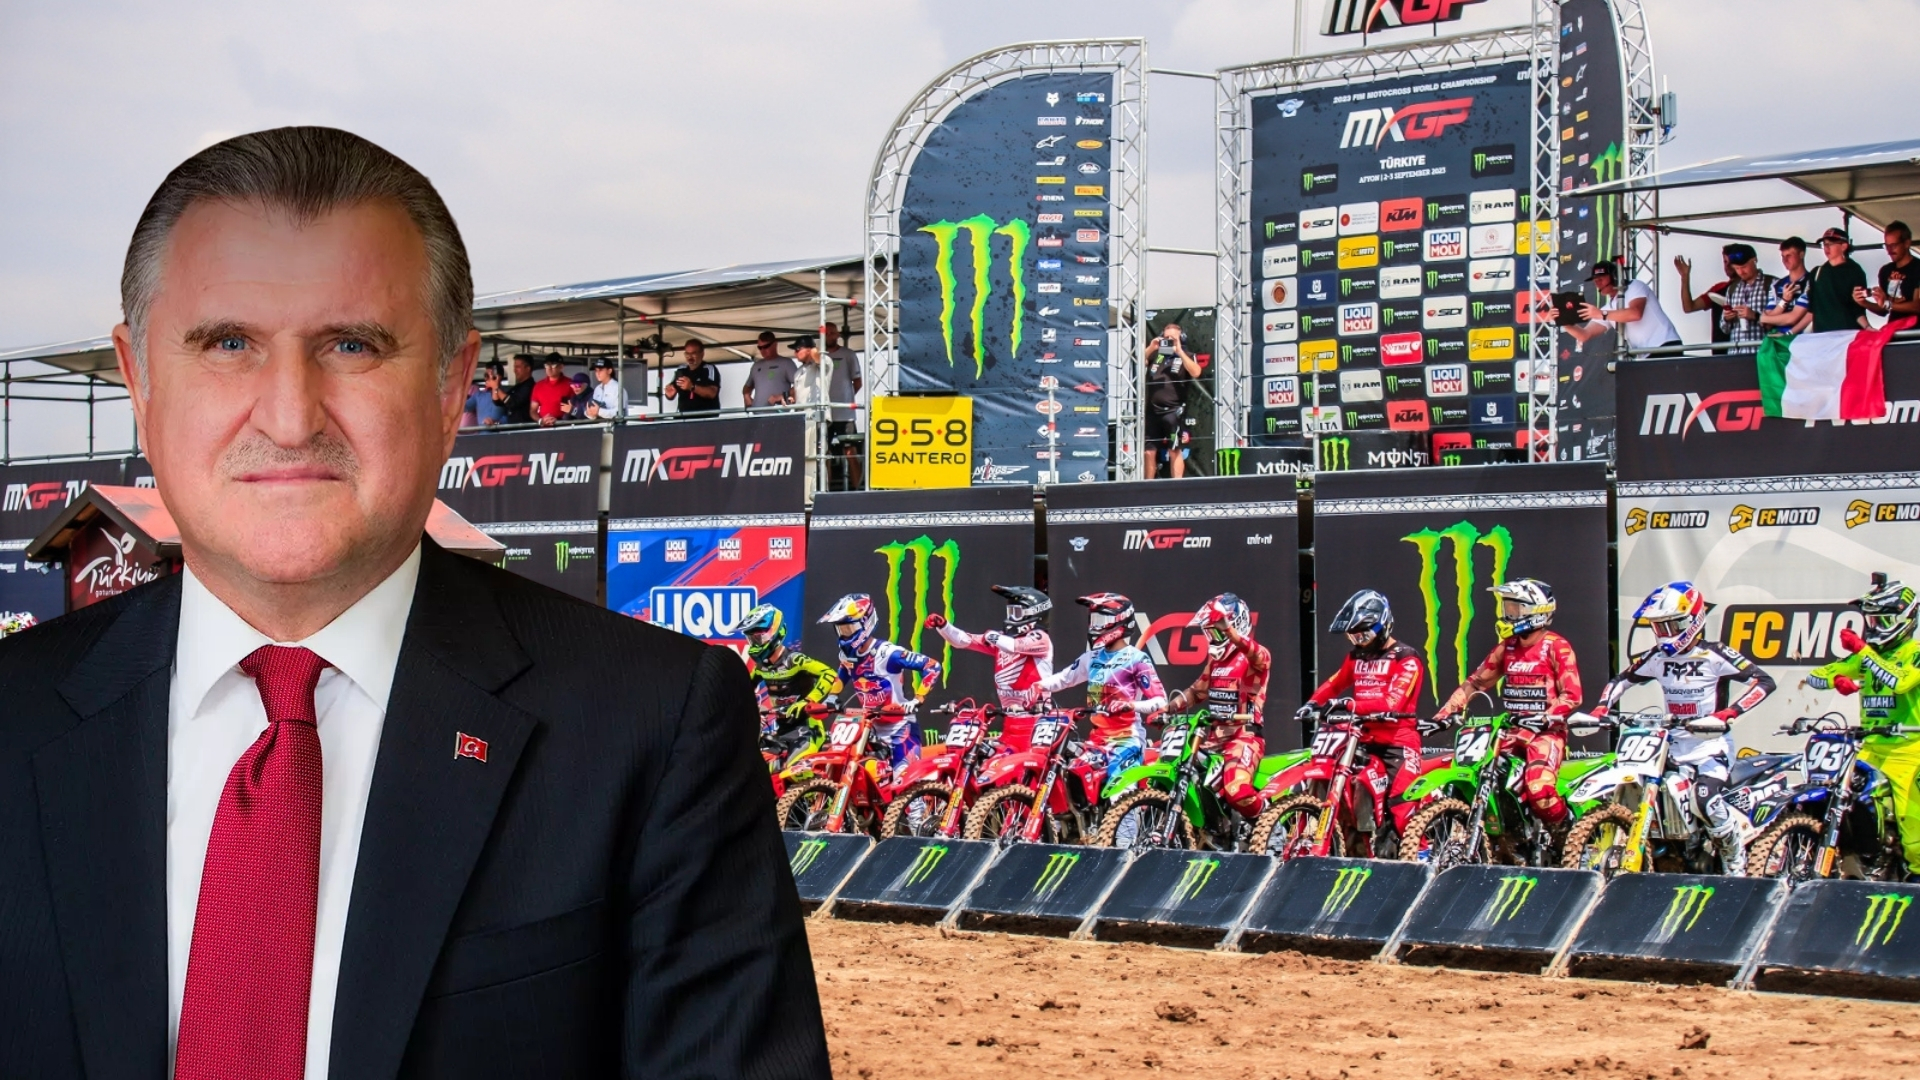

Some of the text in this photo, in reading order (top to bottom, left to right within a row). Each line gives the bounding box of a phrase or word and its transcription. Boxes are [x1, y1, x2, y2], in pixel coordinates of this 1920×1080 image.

[1367, 87, 1411, 99] MOTOCROSS
[1412, 83, 1438, 93] WORLD
[1440, 76, 1497, 90] CHAMPIONSHIP
[1340, 97, 1474, 151] MXGP
[1380, 154, 1426, 170] TÜRKIYE
[1394, 168, 1430, 180] SEPTEMBER
[1484, 201, 1514, 210] RAM
[1386, 207, 1417, 222] KTM
[1430, 232, 1460, 244] LIQUI
[1430, 244, 1461, 258] MOLY
[1274, 256, 1296, 264] RAM
[1393, 277, 1420, 285] RAM
[1344, 307, 1372, 319] LIQUI
[1344, 320, 1372, 332] MOLY
[1432, 368, 1460, 380] LIQUI
[1268, 380, 1293, 392] LIQUI
[1432, 380, 1462, 393] MOLY
[1269, 392, 1294, 404] MOLY
[1394, 410, 1424, 422] KTM
[1306, 422, 1338, 431] VLTA
[876, 452, 966, 464] SANTERO
[619, 542, 640, 551] LIQUI
[666, 541, 686, 550] LIQUI
[719, 540, 740, 549] LIQUI
[770, 538, 790, 548] LIQUI
[619, 552, 640, 562] MOLY
[666, 550, 686, 560] MOLY
[719, 550, 741, 560] MOLY
[770, 548, 792, 558] MOLY
[1864, 658, 1896, 688] YAMAHA
[831, 723, 860, 744] 80
[1160, 730, 1187, 756] 22
[1312, 732, 1348, 756] 517
[1456, 731, 1490, 762] 24
[1620, 736, 1660, 762] 96
[1808, 742, 1850, 771] 93
